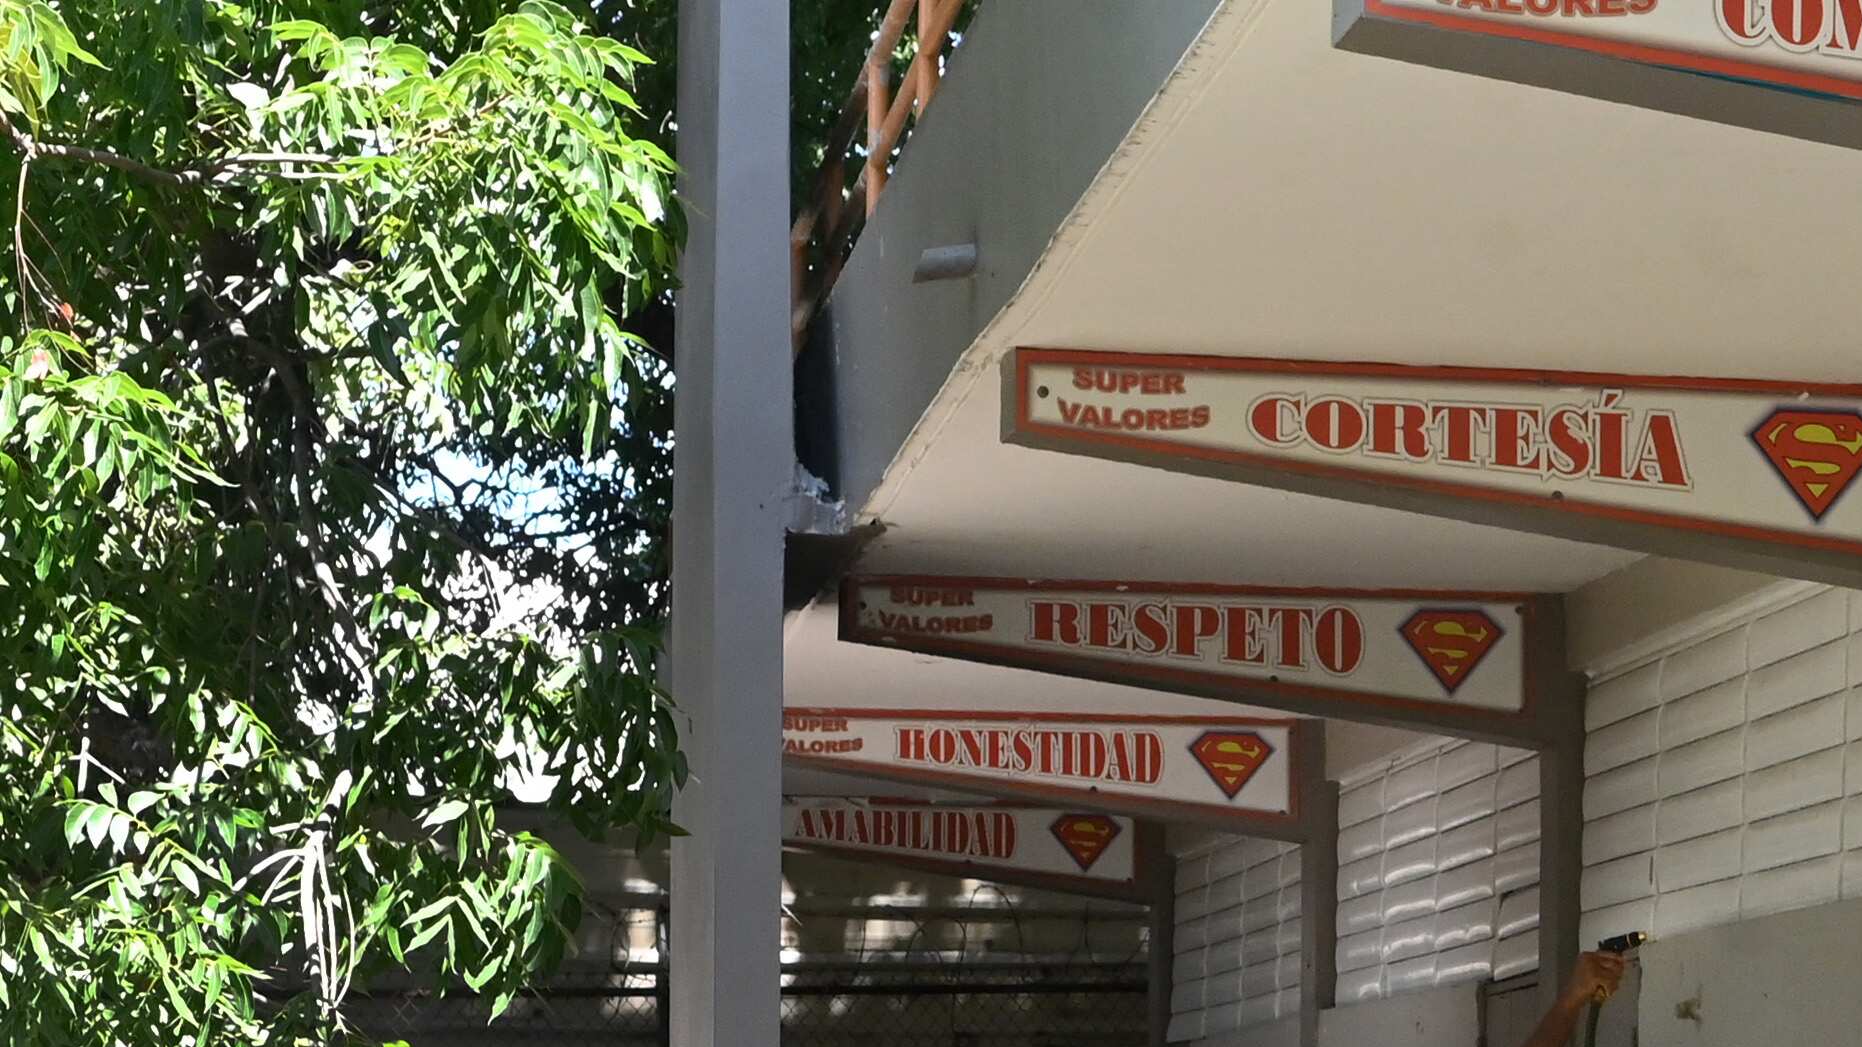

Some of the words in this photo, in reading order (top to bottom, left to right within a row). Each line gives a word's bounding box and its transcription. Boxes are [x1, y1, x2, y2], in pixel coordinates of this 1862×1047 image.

[1071, 366, 1187, 396] SUPER
[1056, 396, 1211, 431] VALORES
[1249, 391, 1691, 488] CORTESÍA
[888, 586, 976, 607] SUPER
[879, 608, 993, 633] VALORES
[1028, 600, 1363, 674] RESPETO
[783, 737, 864, 754] ALORES
[898, 727, 1163, 785] HONESTIDAD
[795, 808, 1017, 860] AMABILIDAD
